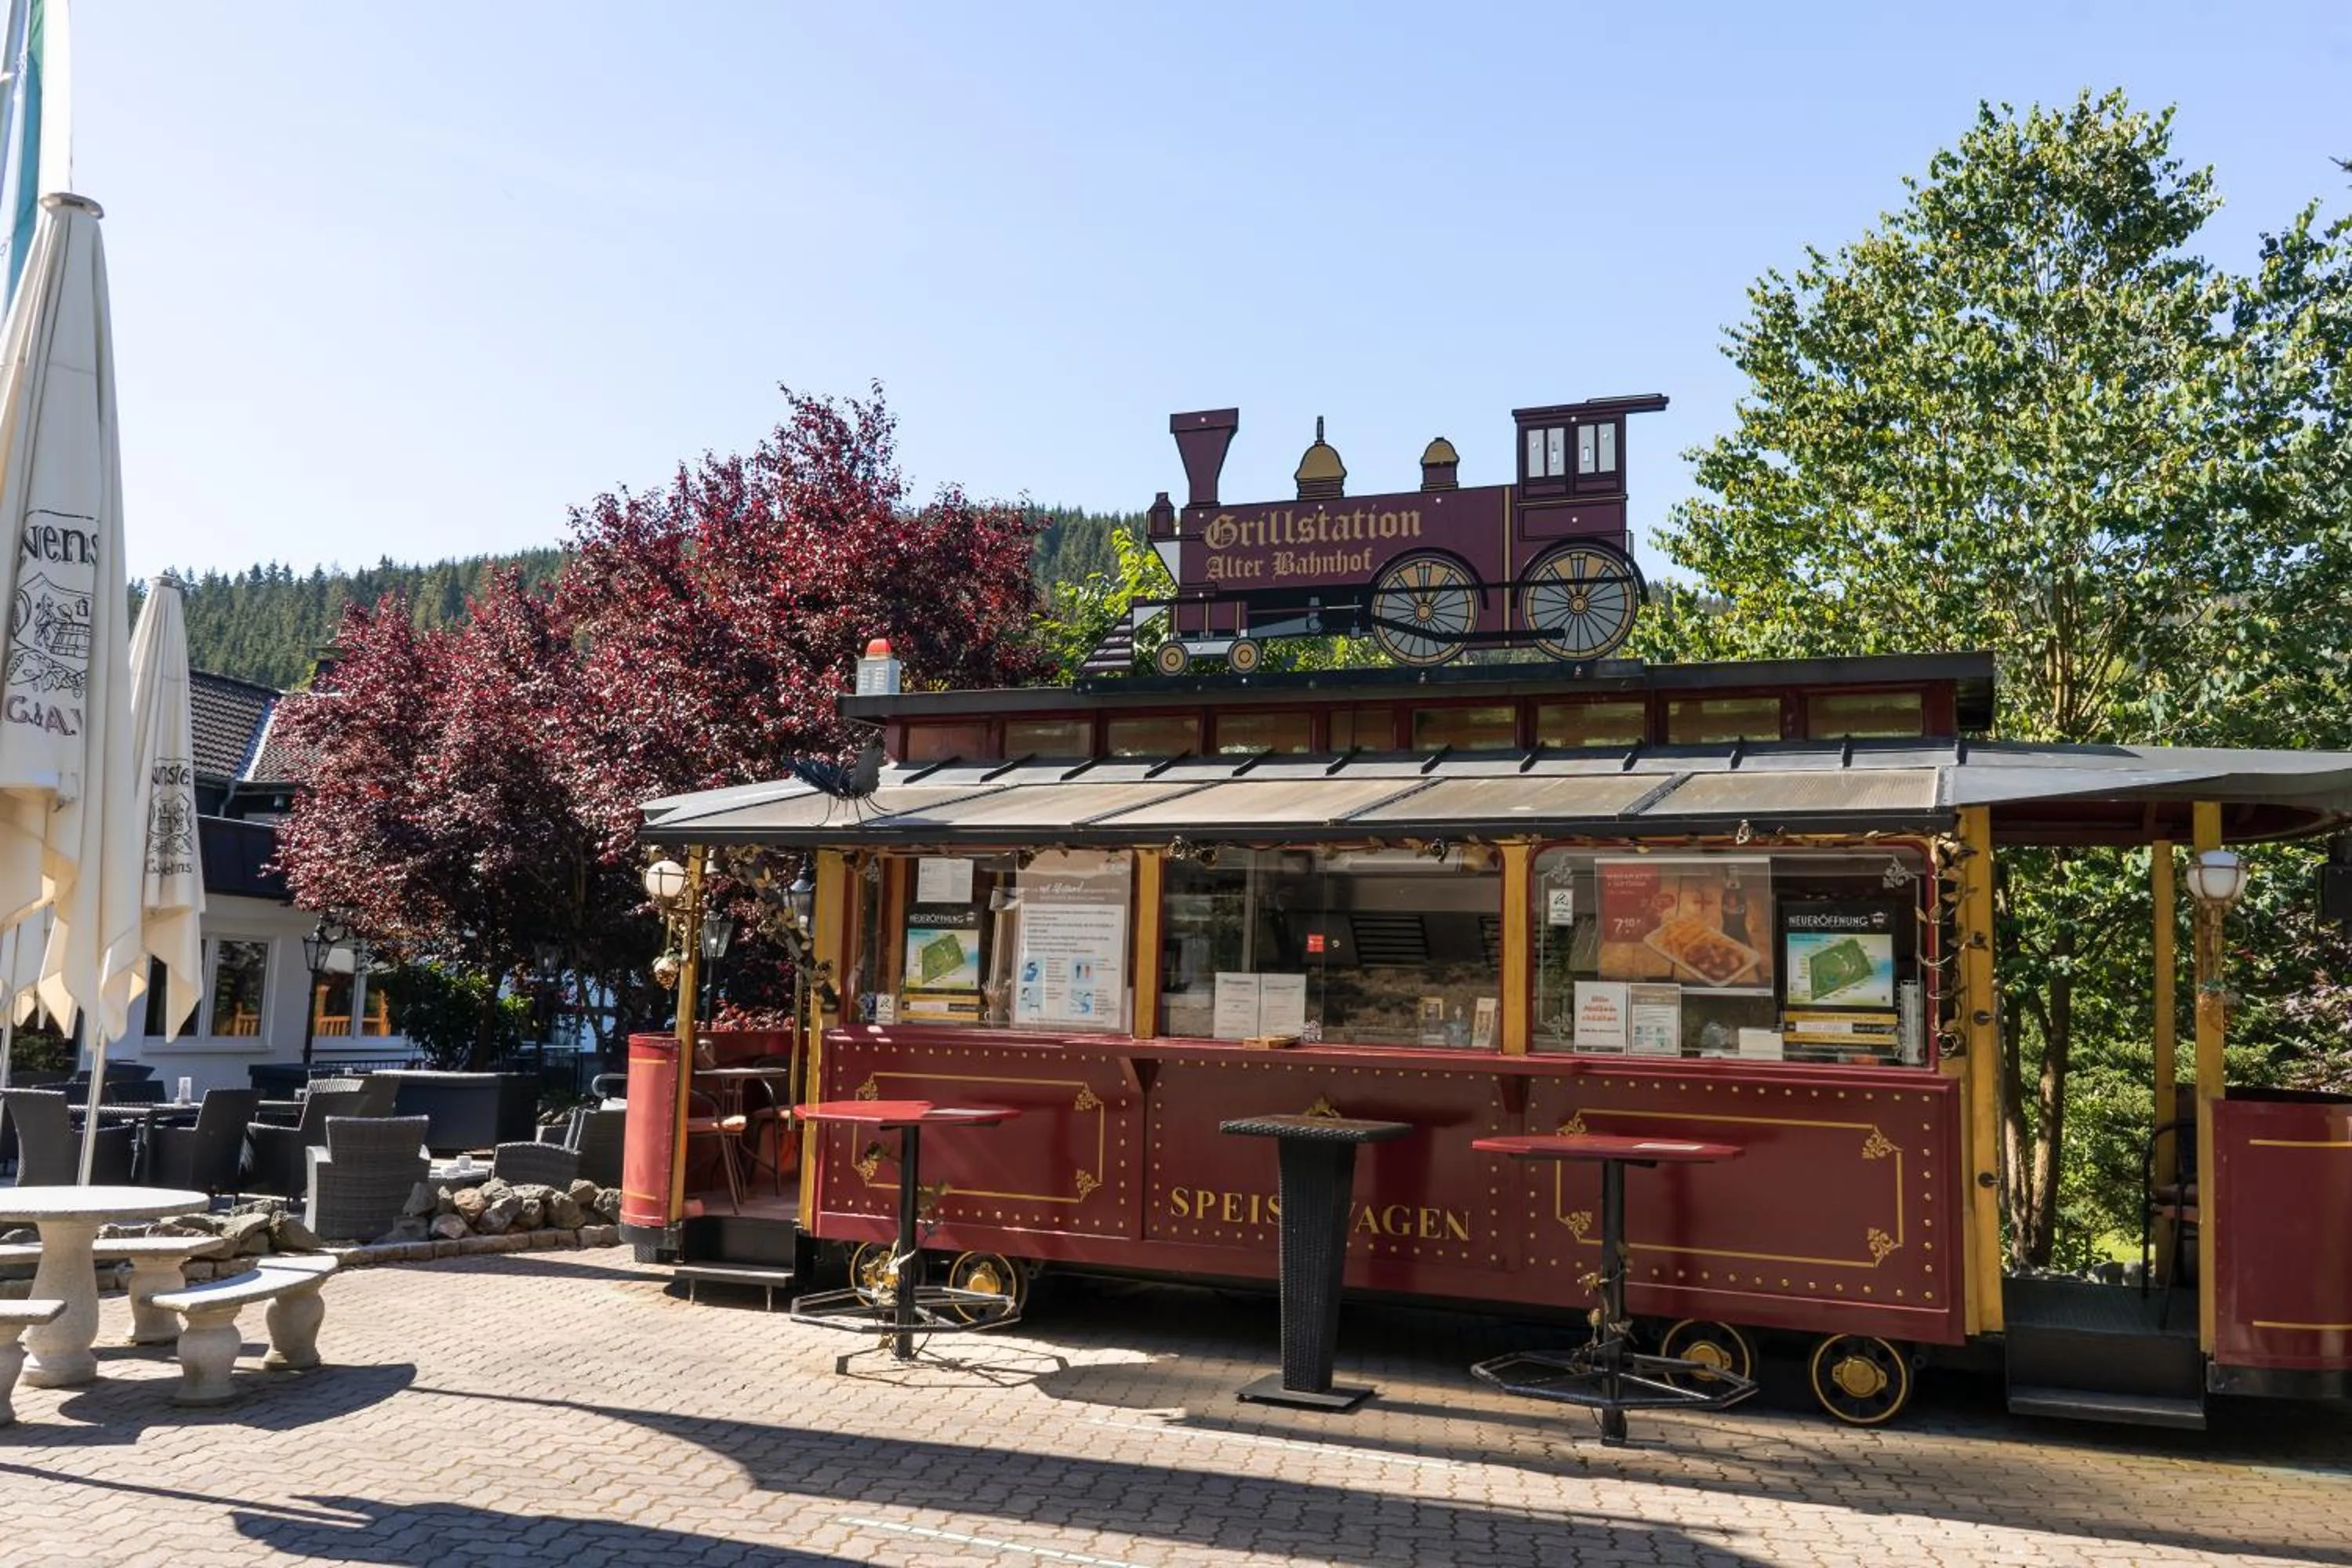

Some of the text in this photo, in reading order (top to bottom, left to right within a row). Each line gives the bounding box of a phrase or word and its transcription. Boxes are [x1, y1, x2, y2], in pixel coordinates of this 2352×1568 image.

[1203, 504, 1422, 550] Grillstation
[1205, 546, 1374, 581] Alter Bahnhof
[1788, 913, 1868, 927] NEUERÖFFNUNG
[1170, 1185, 1471, 1242] SPEISAGEN
